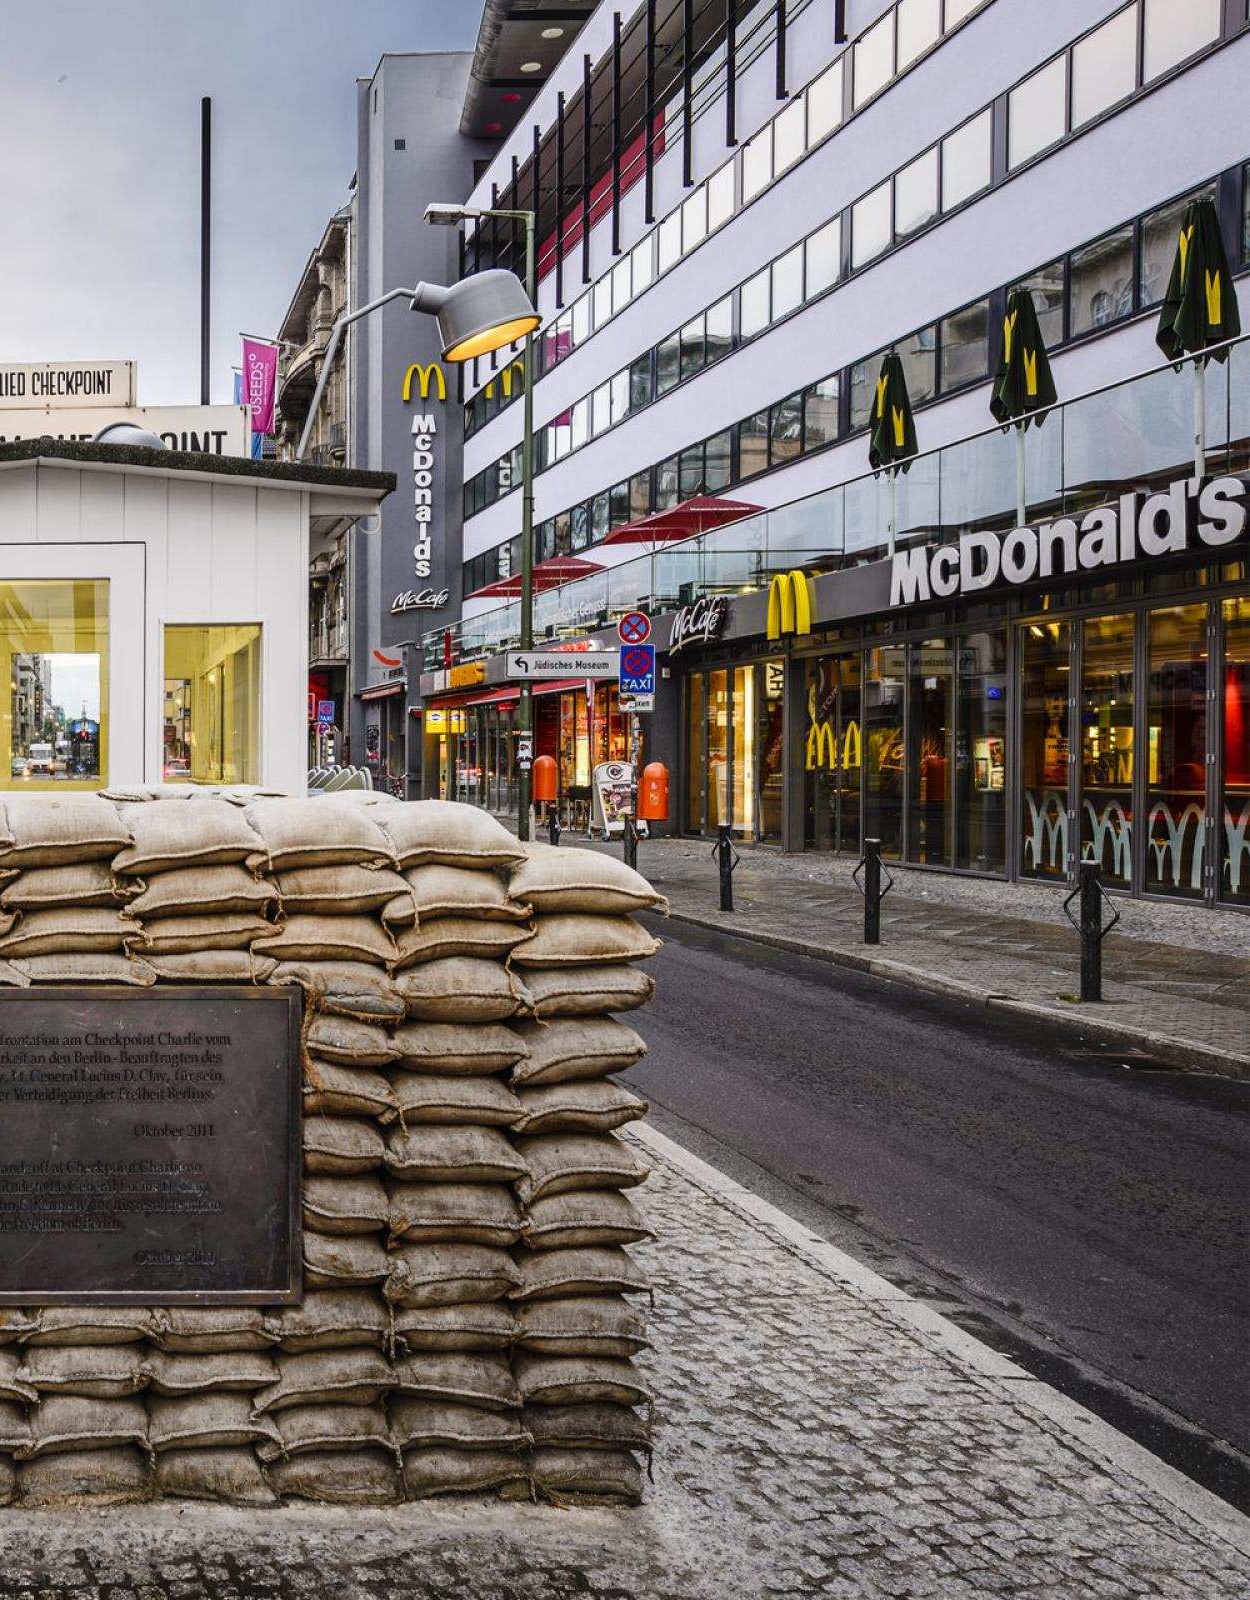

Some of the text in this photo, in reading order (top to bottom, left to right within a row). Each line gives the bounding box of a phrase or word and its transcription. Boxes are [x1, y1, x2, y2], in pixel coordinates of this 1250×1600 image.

[32, 370, 113, 396] CHECKPOINT
[411, 414, 436, 578] McDonalds
[889, 477, 1246, 607] McDonald's
[533, 660, 609, 671] Jüdisches Museum
[622, 678, 651, 690] TAXI
[62, 1034, 82, 1047] am
[84, 1034, 155, 1050] Checkpoint
[157, 1034, 203, 1047] Charlie
[205, 1034, 231, 1047] vom
[30, 1052, 46, 1065] an
[48, 1052, 71, 1065] den
[201, 1052, 223, 1065] des
[30, 1070, 77, 1082] General
[81, 1070, 121, 1082] Lucius
[197, 1070, 223, 1082] sein
[96, 1088, 114, 1101] der
[119, 1088, 164, 1101] Freiheit
[134, 1124, 184, 1137] Oktober
